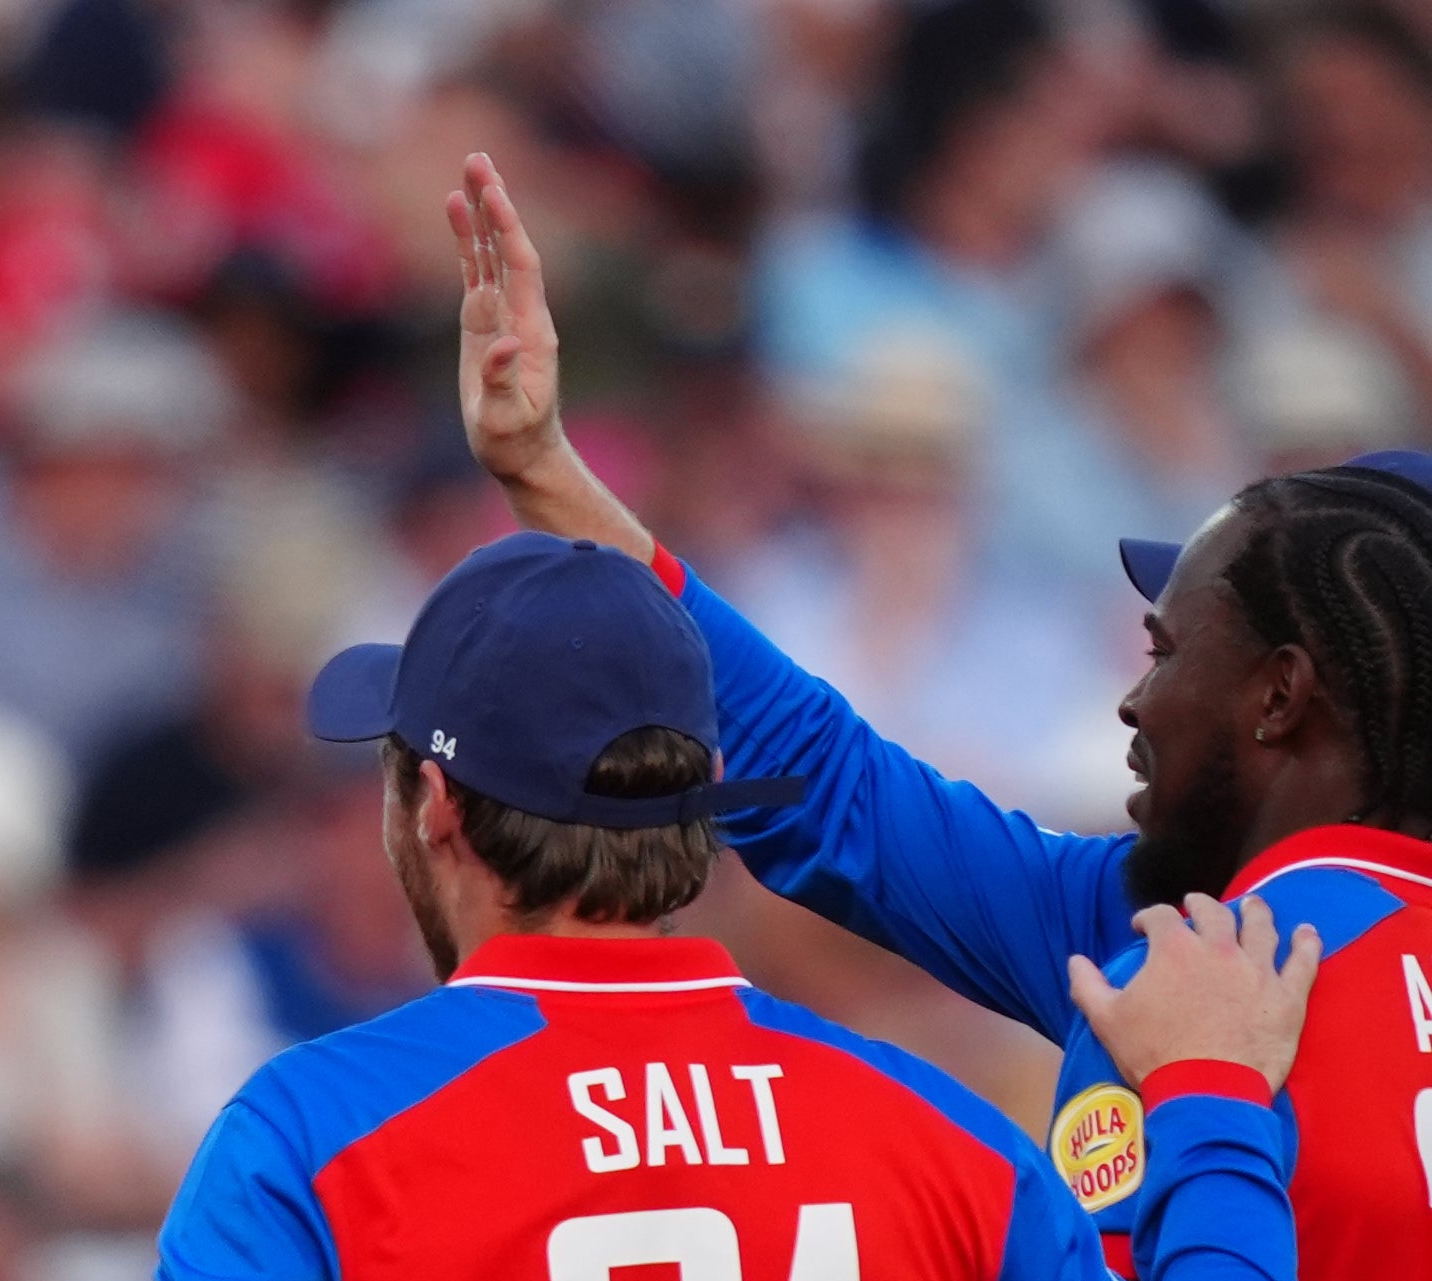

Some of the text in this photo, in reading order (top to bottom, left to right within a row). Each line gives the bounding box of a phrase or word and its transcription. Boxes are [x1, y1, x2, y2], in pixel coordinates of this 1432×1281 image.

[431, 729, 457, 760] 94
[567, 1061, 785, 1174] SALT
[1070, 1106, 1127, 1160] HULA
